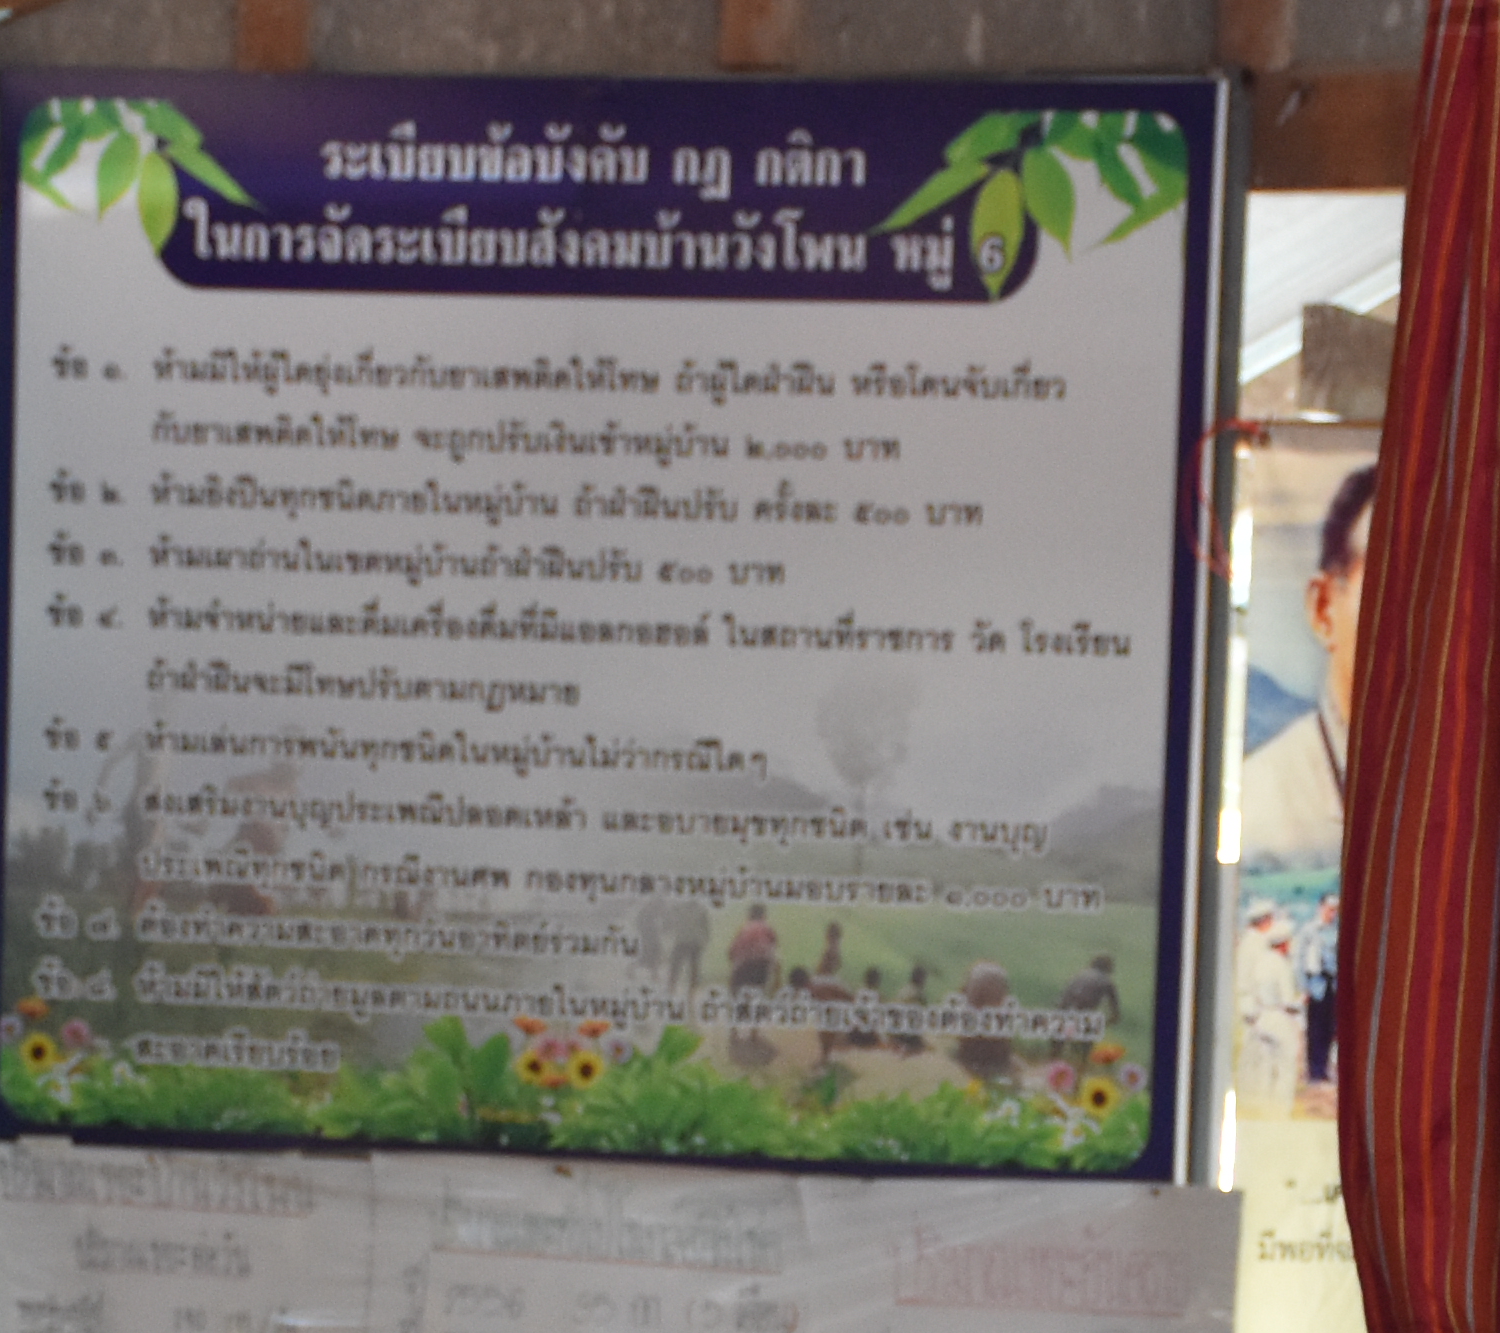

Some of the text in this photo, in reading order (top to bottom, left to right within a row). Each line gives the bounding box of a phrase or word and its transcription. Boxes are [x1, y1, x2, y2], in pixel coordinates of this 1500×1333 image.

[755, 129, 868, 187] กติกา
[890, 215, 956, 291] หมู่
[978, 235, 1005, 273] 6
[1020, 618, 1132, 659] โรงเรียน
